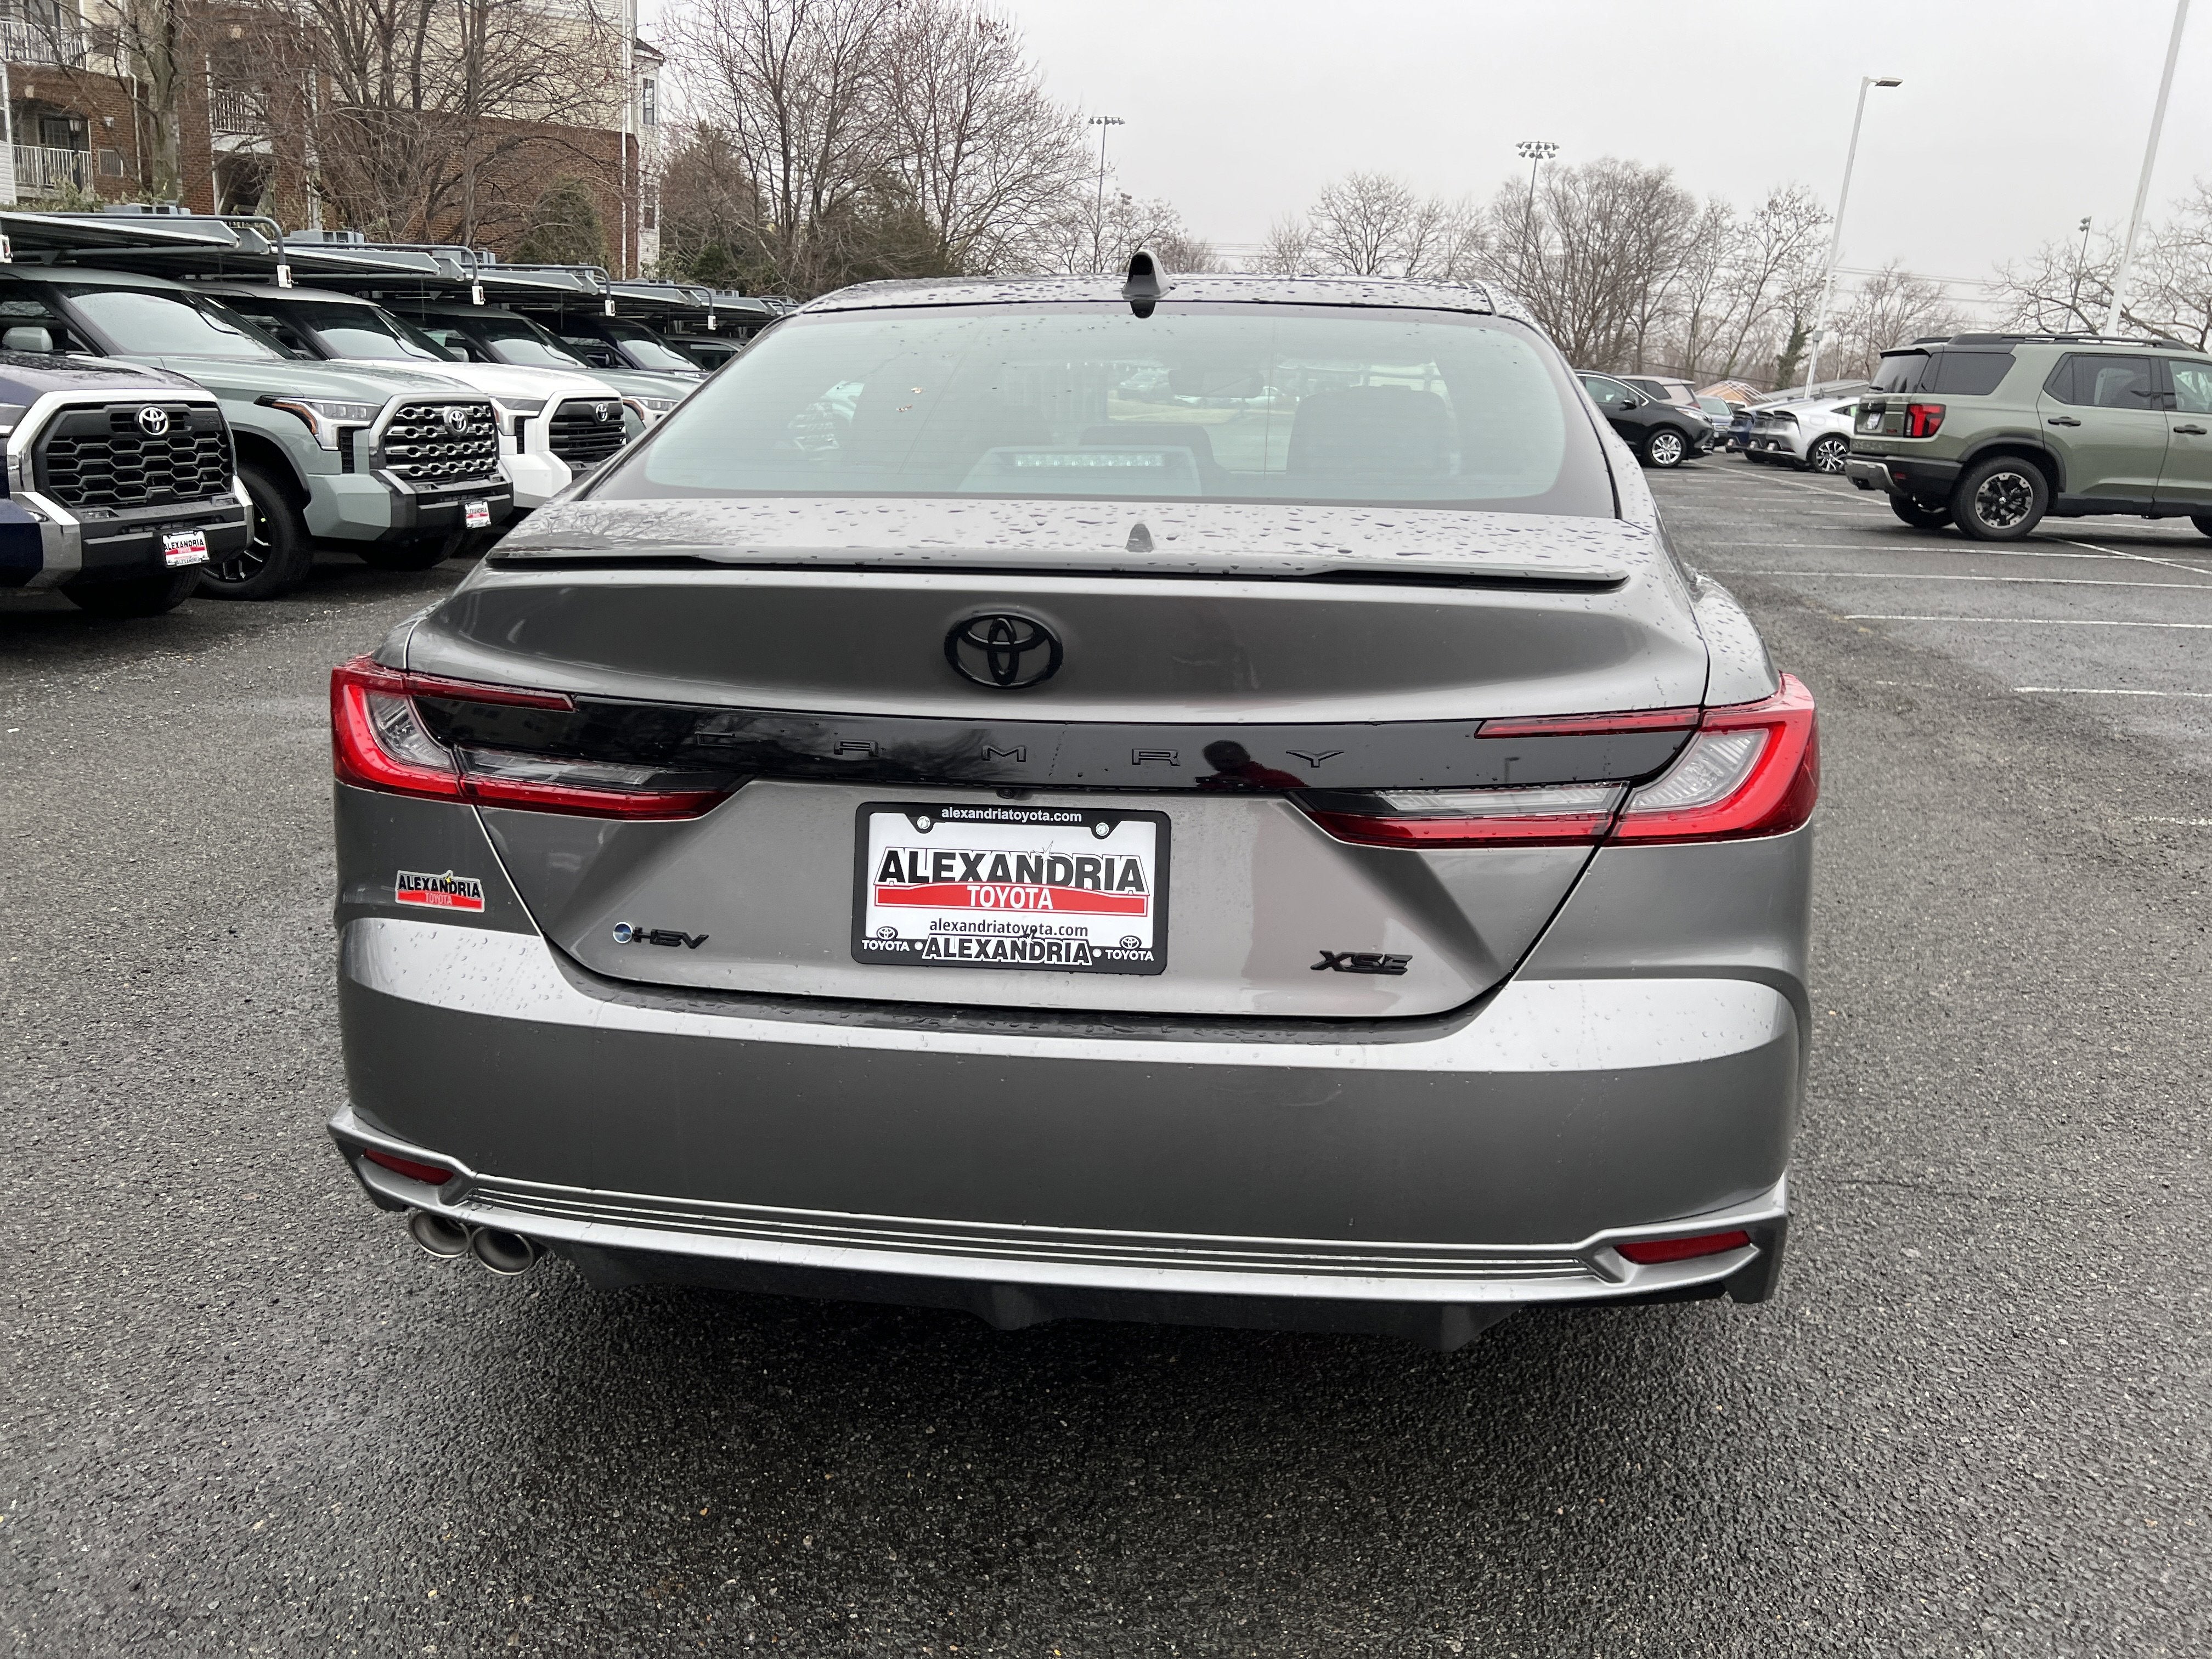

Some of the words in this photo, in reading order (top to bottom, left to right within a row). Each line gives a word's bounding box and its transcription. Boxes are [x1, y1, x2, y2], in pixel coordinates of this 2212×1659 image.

[165, 539, 204, 550] ALEXANDRIA
[695, 731, 1345, 768] CAMRY
[941, 806, 1082, 823] alexandriatoyota.com
[878, 850, 1145, 892] ALEXANDRIA
[398, 874, 481, 898] ALEXANDRIA
[967, 885, 1054, 910] TOYOTA
[425, 893, 453, 905] TOYOTA
[929, 917, 1088, 937] alexandriatoyota.com
[861, 939, 910, 952] TOYOTA
[924, 936, 1091, 964] ALEXANDRIA
[1105, 949, 1154, 961] TOYOTA
[1310, 950, 1413, 975] XSE
